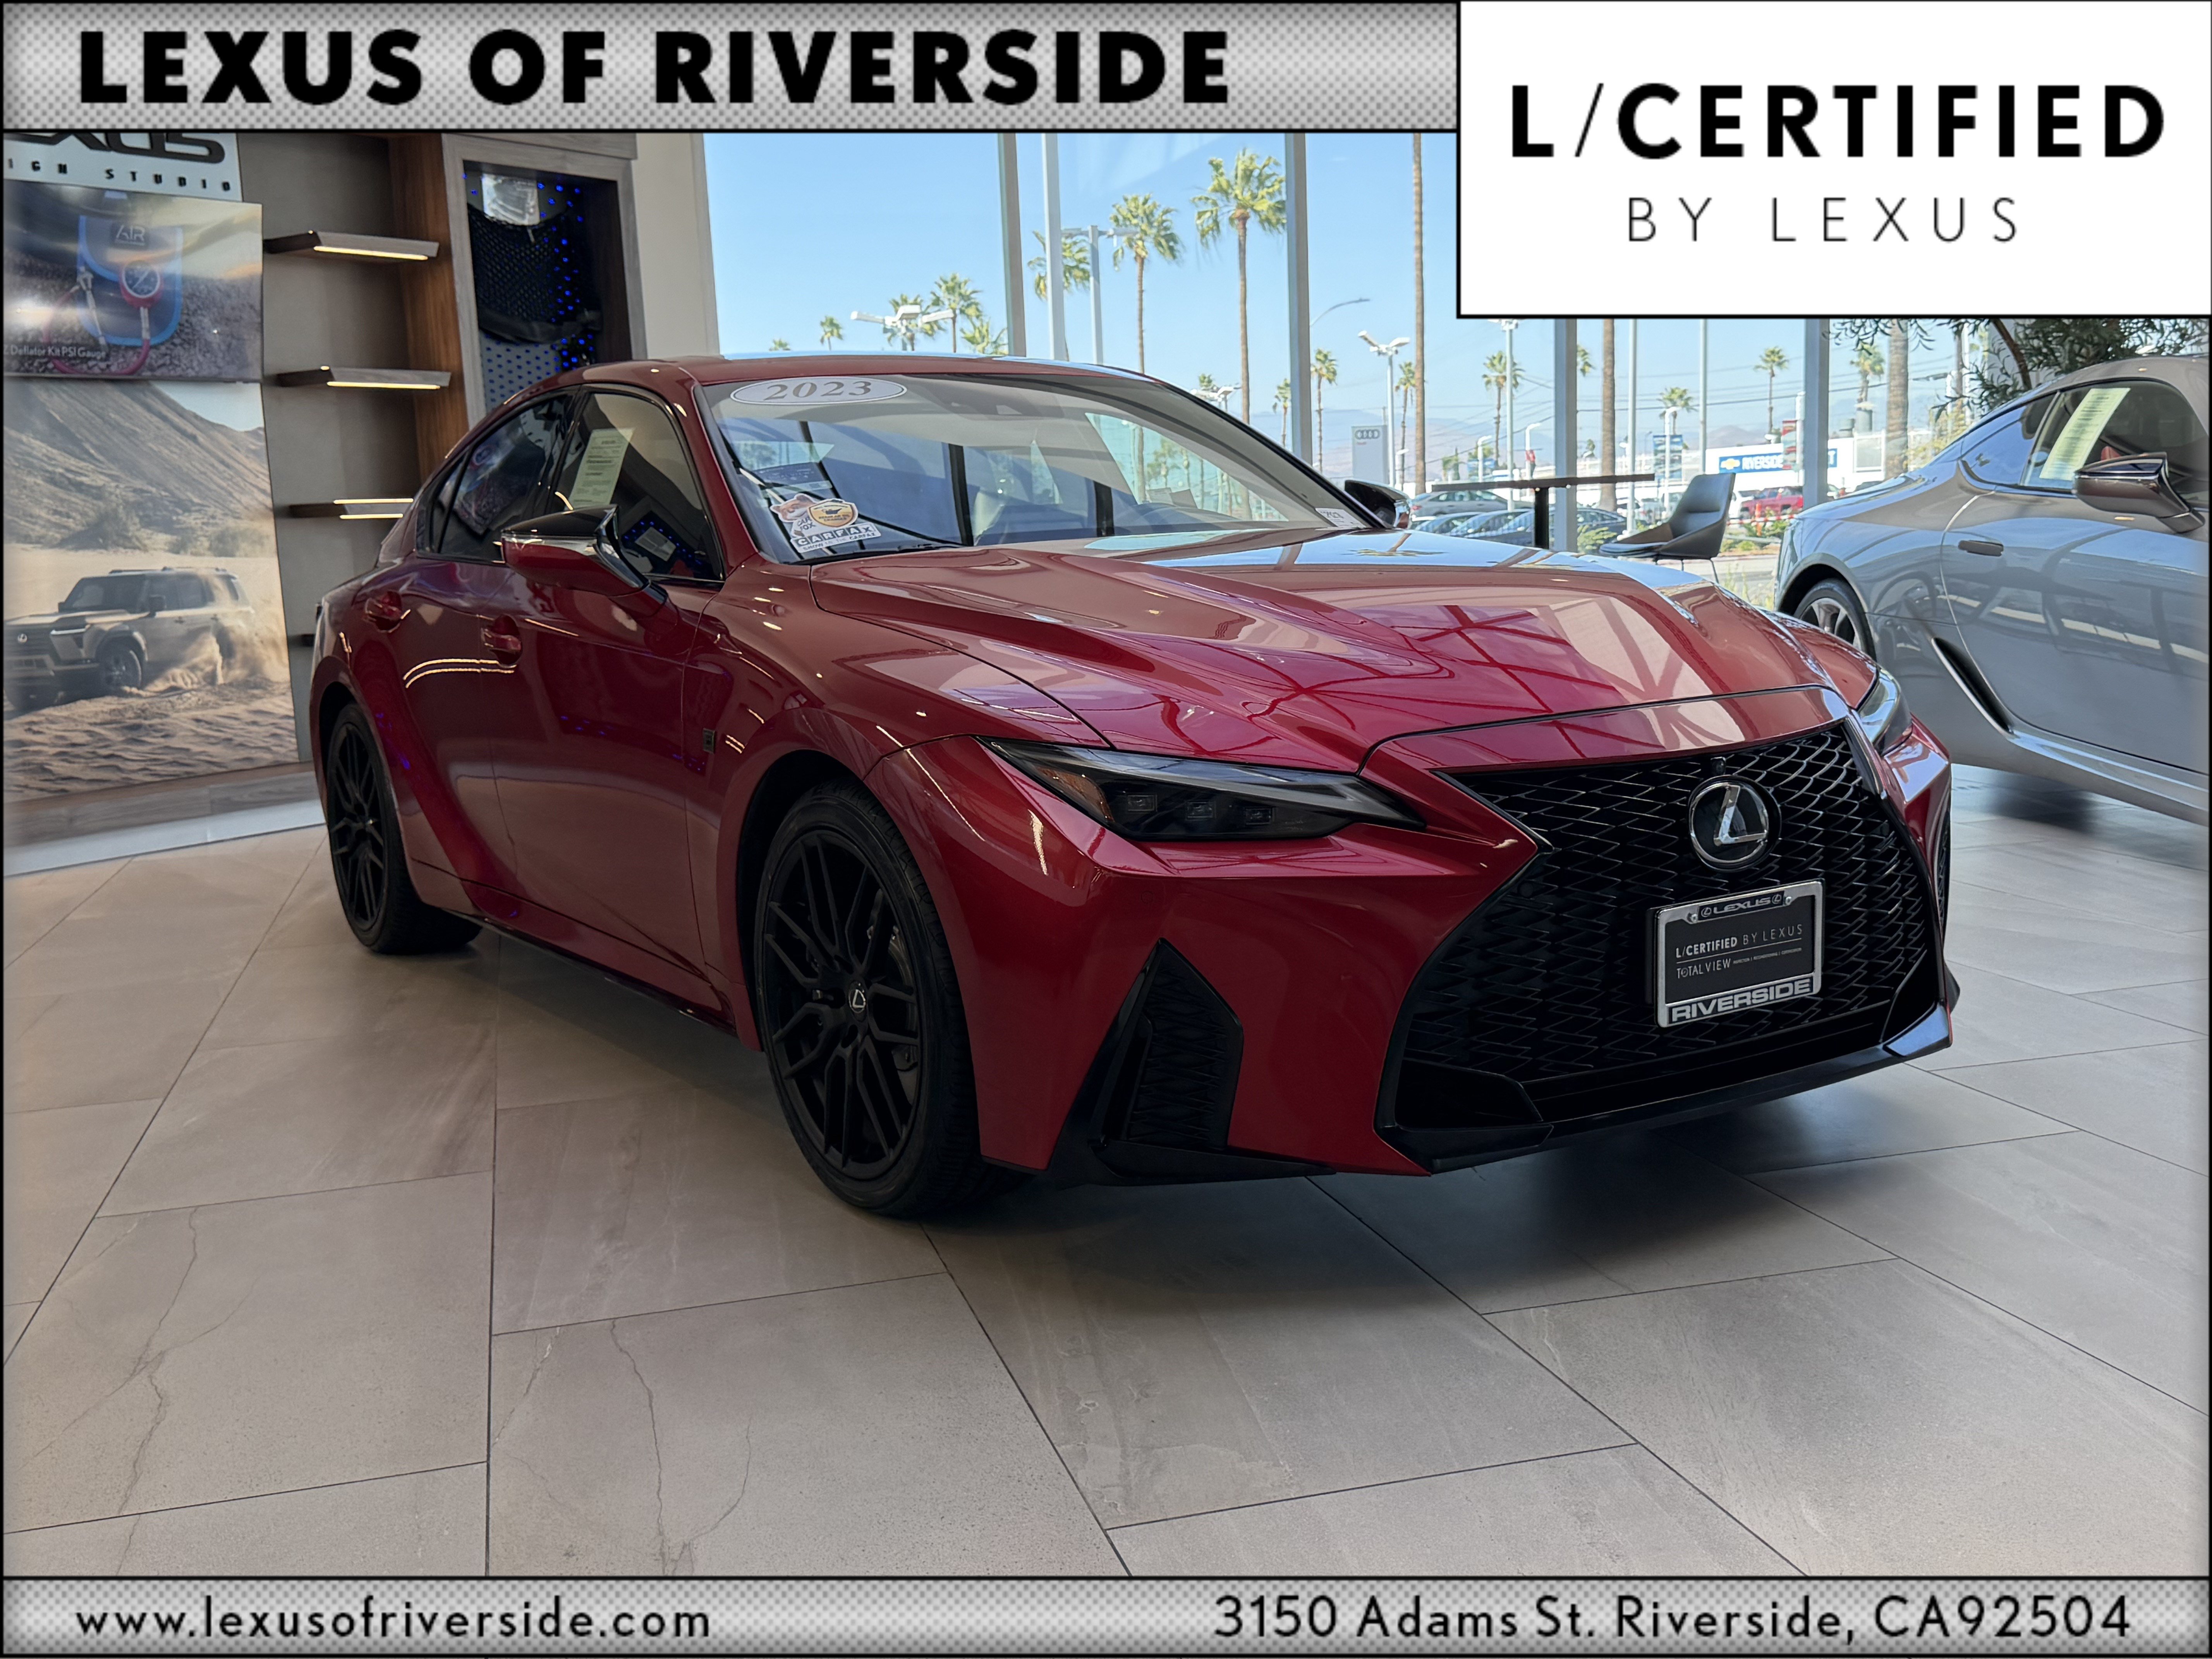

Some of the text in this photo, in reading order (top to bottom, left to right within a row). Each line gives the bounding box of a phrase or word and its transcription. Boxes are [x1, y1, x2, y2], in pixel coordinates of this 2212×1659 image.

[105, 168, 230, 191] STUDIO
[116, 225, 145, 242] AIR
[10, 345, 45, 356] Deflator
[62, 346, 76, 357] PSI
[77, 347, 106, 359] Gauge
[763, 381, 872, 401] 2023
[795, 526, 872, 546] CARFAX
[1713, 897, 1771, 914] LEXUS
[1743, 932, 1757, 945] BY
[1763, 924, 1802, 941] LEXUS
[1705, 958, 1731, 972] VIEW
[1672, 978, 1810, 1022] RIVERSIDE
